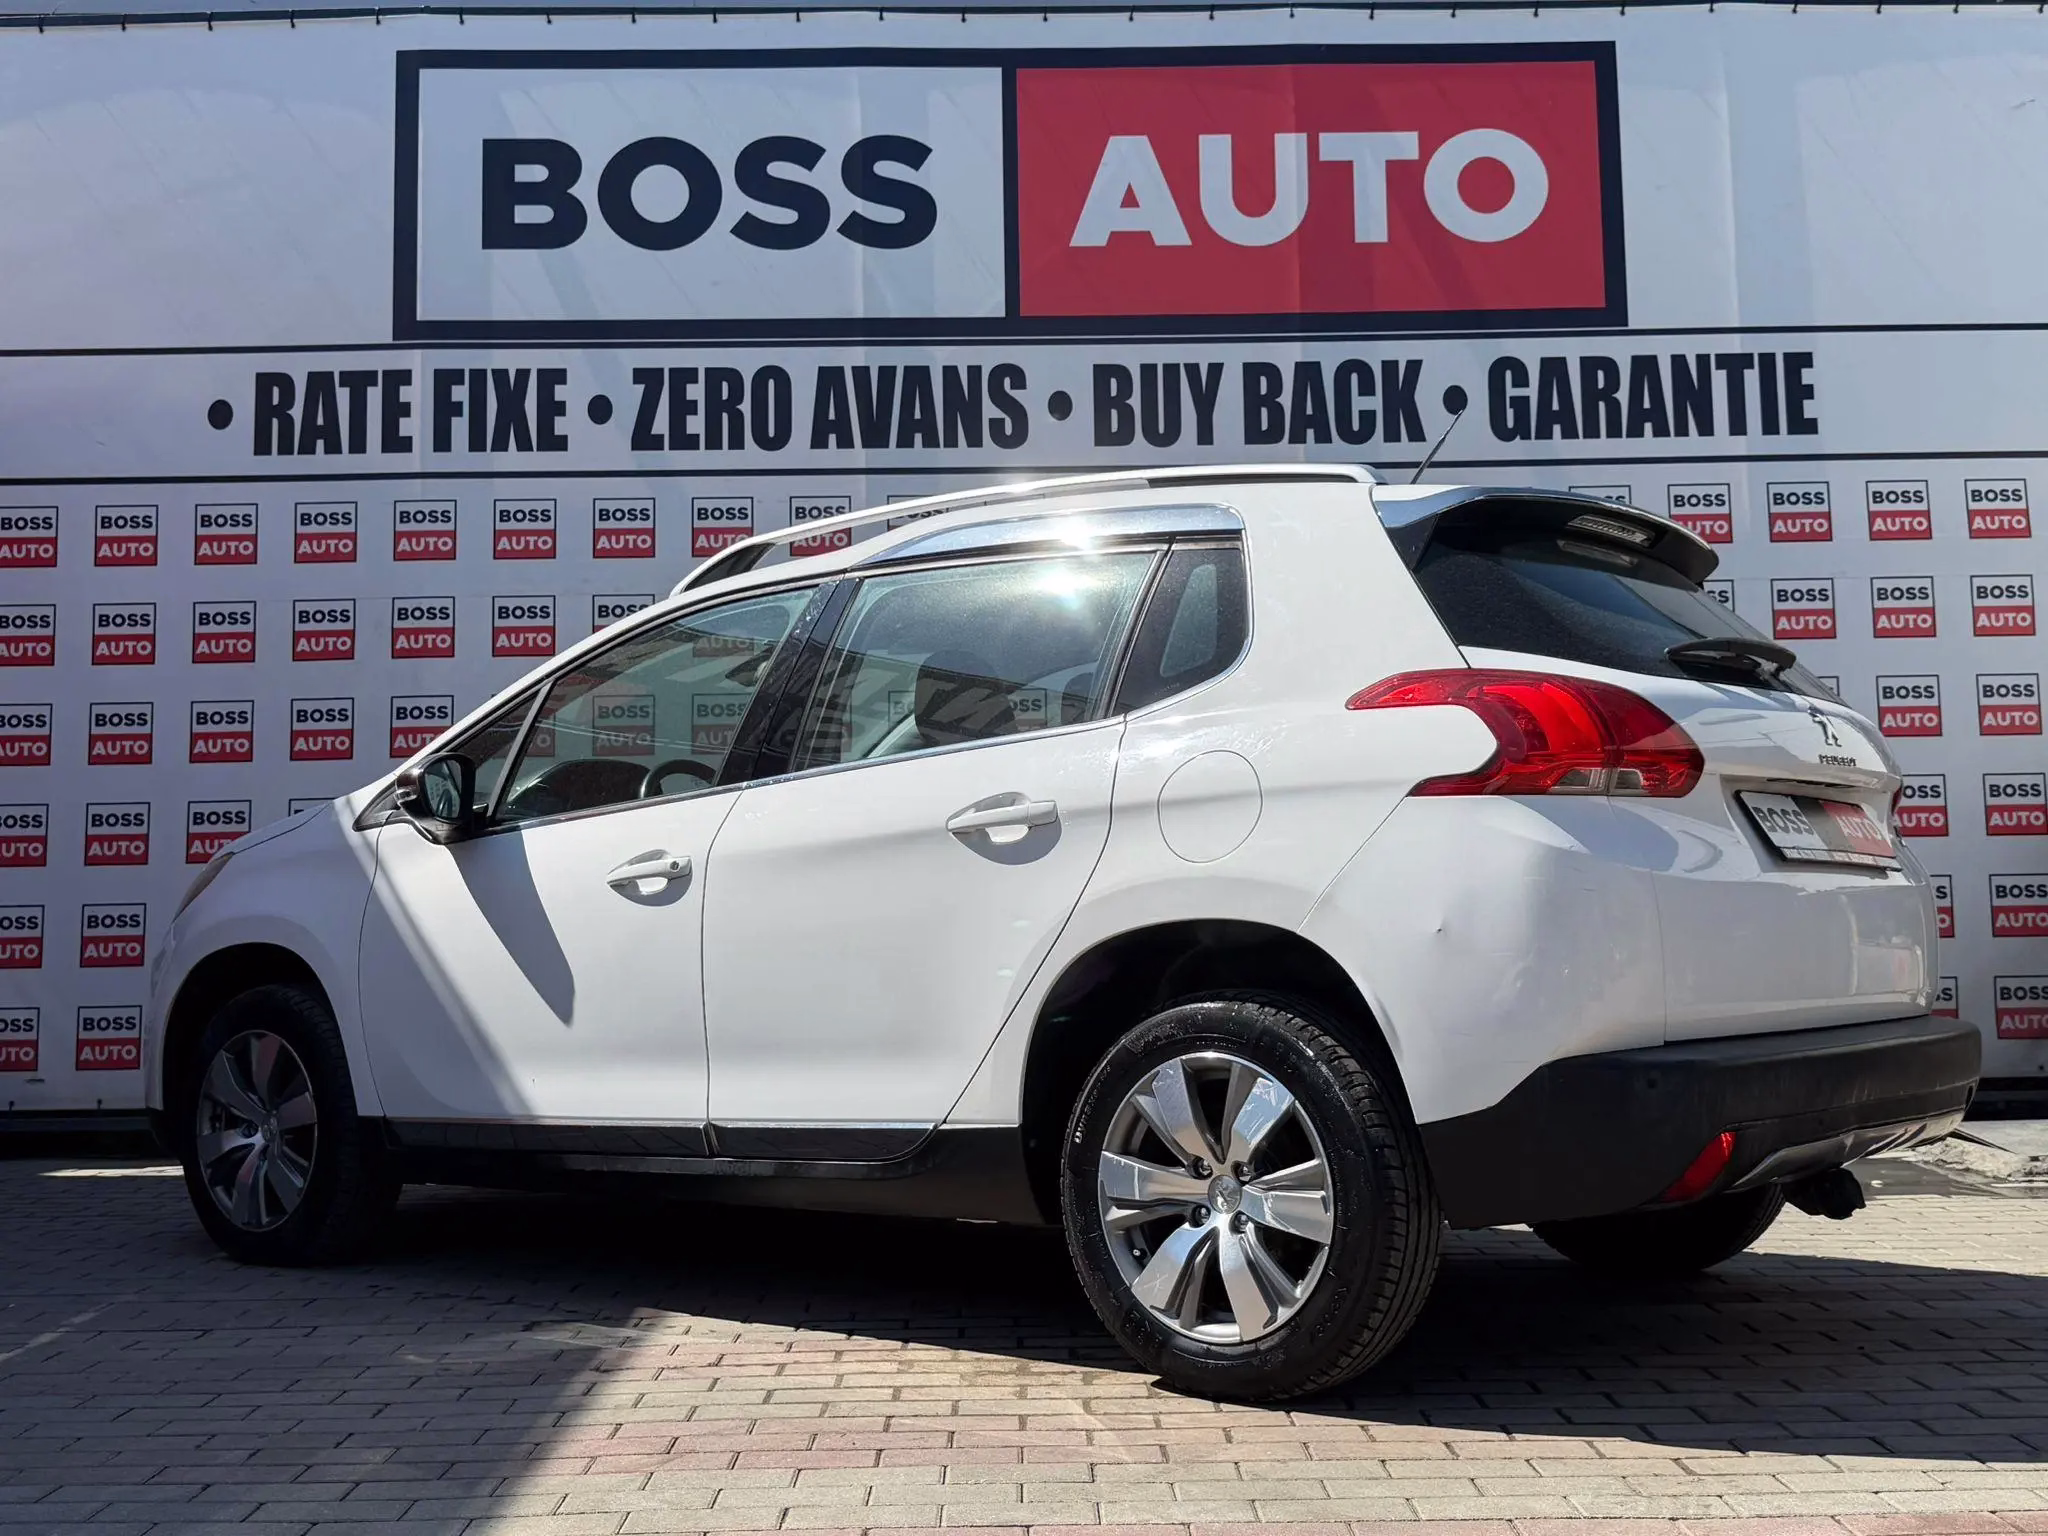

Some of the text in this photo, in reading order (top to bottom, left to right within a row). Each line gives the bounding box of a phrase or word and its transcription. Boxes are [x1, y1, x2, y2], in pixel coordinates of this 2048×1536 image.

[482, 127, 1550, 251] BOSS AUTO
[253, 351, 1819, 456] RATE FIXE ZERO AVANS BUY BACK GARANTIE
[1673, 493, 1727, 508] BOSS
[1772, 491, 1825, 506] BOSS
[1871, 490, 1924, 504] BOSS
[1970, 488, 2023, 503] BOSS
[100, 514, 154, 529] BOSS
[200, 513, 253, 528] BOSS
[299, 511, 353, 526] BOSS
[399, 509, 452, 524] BOSS
[499, 508, 552, 523] BOSS
[598, 507, 651, 522] BOSS
[697, 507, 749, 521] BOSS
[1, 516, 53, 531] BOSS
[1772, 518, 1828, 533] AUTO
[1871, 516, 1928, 531] AUTO
[1971, 515, 2028, 530] AUTO
[98, 541, 155, 557] AUTO
[197, 540, 254, 556] AUTO
[297, 538, 354, 555] AUTO
[396, 536, 453, 552] AUTO
[496, 535, 553, 551] AUTO
[596, 534, 652, 549] AUTO
[0, 543, 54, 558] AUTO
[1776, 588, 1830, 603] BOSS
[1876, 586, 1930, 601] BOSS
[1976, 584, 2029, 599] BOSS
[198, 611, 251, 626] BOSS
[298, 609, 351, 624] BOSS
[397, 605, 450, 621] BOSS
[497, 604, 551, 620] BOSS
[1976, 612, 2032, 628] AUTO
[0, 614, 51, 629] BOSS
[98, 613, 151, 628] BOSS
[1776, 615, 1833, 631] AUTO
[1876, 613, 1932, 629] AUTO
[95, 640, 152, 656] AUTO
[195, 638, 252, 654] AUTO
[296, 636, 352, 652] AUTO
[395, 634, 451, 650] AUTO
[495, 632, 552, 648] AUTO
[1881, 685, 1935, 700] BOSS
[1982, 683, 2035, 698] BOSS
[195, 711, 249, 726] BOSS
[295, 708, 349, 724] BOSS
[395, 705, 449, 720] BOSS
[597, 704, 650, 720] BOSS
[1882, 712, 1938, 728] AUTO
[1982, 711, 2038, 727] AUTO
[94, 713, 148, 728] BOSS
[92, 740, 149, 756] AUTO
[192, 738, 250, 754] AUTO
[293, 736, 350, 752] AUTO
[1988, 783, 2042, 798] BOSS
[0, 814, 44, 830] OSS
[91, 813, 145, 828] BOSS
[192, 810, 246, 826] BOSS
[1751, 806, 1882, 841] BOSS AUTO
[1988, 811, 2045, 827] AUTO
[0, 842, 43, 858] UTO
[88, 841, 145, 857] AUTO
[1995, 884, 2048, 900] BOSS
[87, 913, 141, 929] BOSS
[1995, 912, 2048, 928] AUTO
[84, 942, 141, 959] AUTO
[82, 1016, 137, 1031] BOSS
[80, 1045, 137, 1061] AUTO
